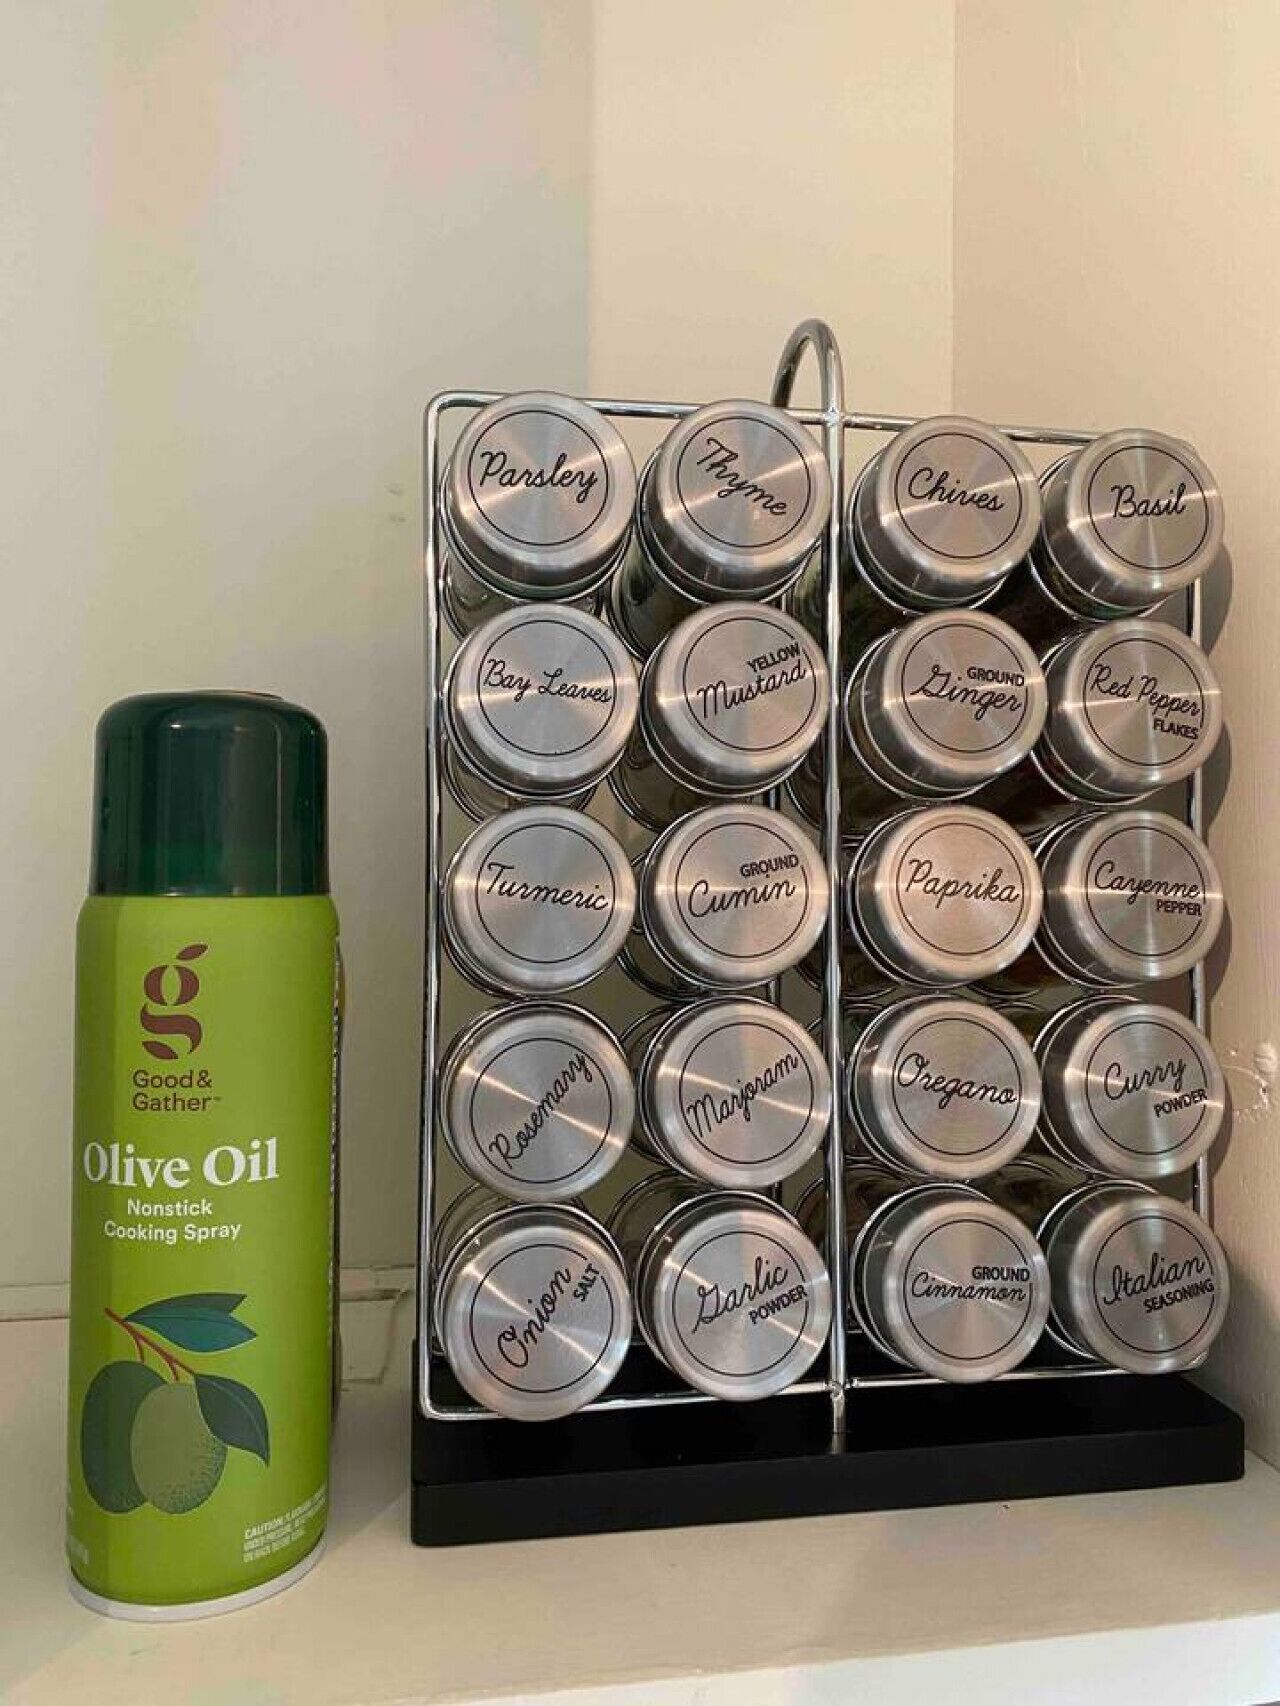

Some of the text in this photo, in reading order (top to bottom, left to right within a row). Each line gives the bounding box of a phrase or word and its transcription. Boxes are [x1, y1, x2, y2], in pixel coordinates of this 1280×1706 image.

[479, 450, 598, 503] Parsley
[696, 438, 787, 516] Thyme
[908, 467, 1006, 511] Chives
[1111, 483, 1186, 519] Basil
[747, 643, 801, 673] YELLOW
[966, 667, 1025, 686] GROUND
[483, 659, 614, 702] Bay Leaves
[698, 659, 806, 719] Mustard
[910, 664, 1022, 721] Ginger
[1090, 664, 1201, 717] Red Pepper
[1154, 717, 1199, 740] FLAKES
[487, 862, 609, 911] Turmeric
[740, 854, 800, 878] GROUND
[906, 859, 1022, 909] Paprika
[1095, 860, 1201, 905] Cayenne
[688, 874, 796, 917] Cumin
[1155, 899, 1202, 917] PEPPER
[132, 1069, 192, 1089] Good
[686, 1052, 798, 1137] Marjoram
[899, 1052, 1018, 1109] Oregano
[1104, 1058, 1186, 1100] Curry
[489, 1051, 593, 1169] Rosemary
[1154, 1088, 1208, 1118] POWDER
[83, 1137, 280, 1190] Olive Oil
[127, 1199, 213, 1217] Nonstick
[104, 1221, 242, 1245] Cooking Spray
[572, 1263, 600, 1302] SALT
[691, 1256, 789, 1335] Garlic
[911, 1272, 1026, 1302] Cinnamon
[972, 1266, 1031, 1282] GROUND
[1103, 1252, 1204, 1305] Italian
[497, 1267, 572, 1368] Onion
[748, 1284, 808, 1324] POWDER
[1143, 1279, 1215, 1313] SEASONING
